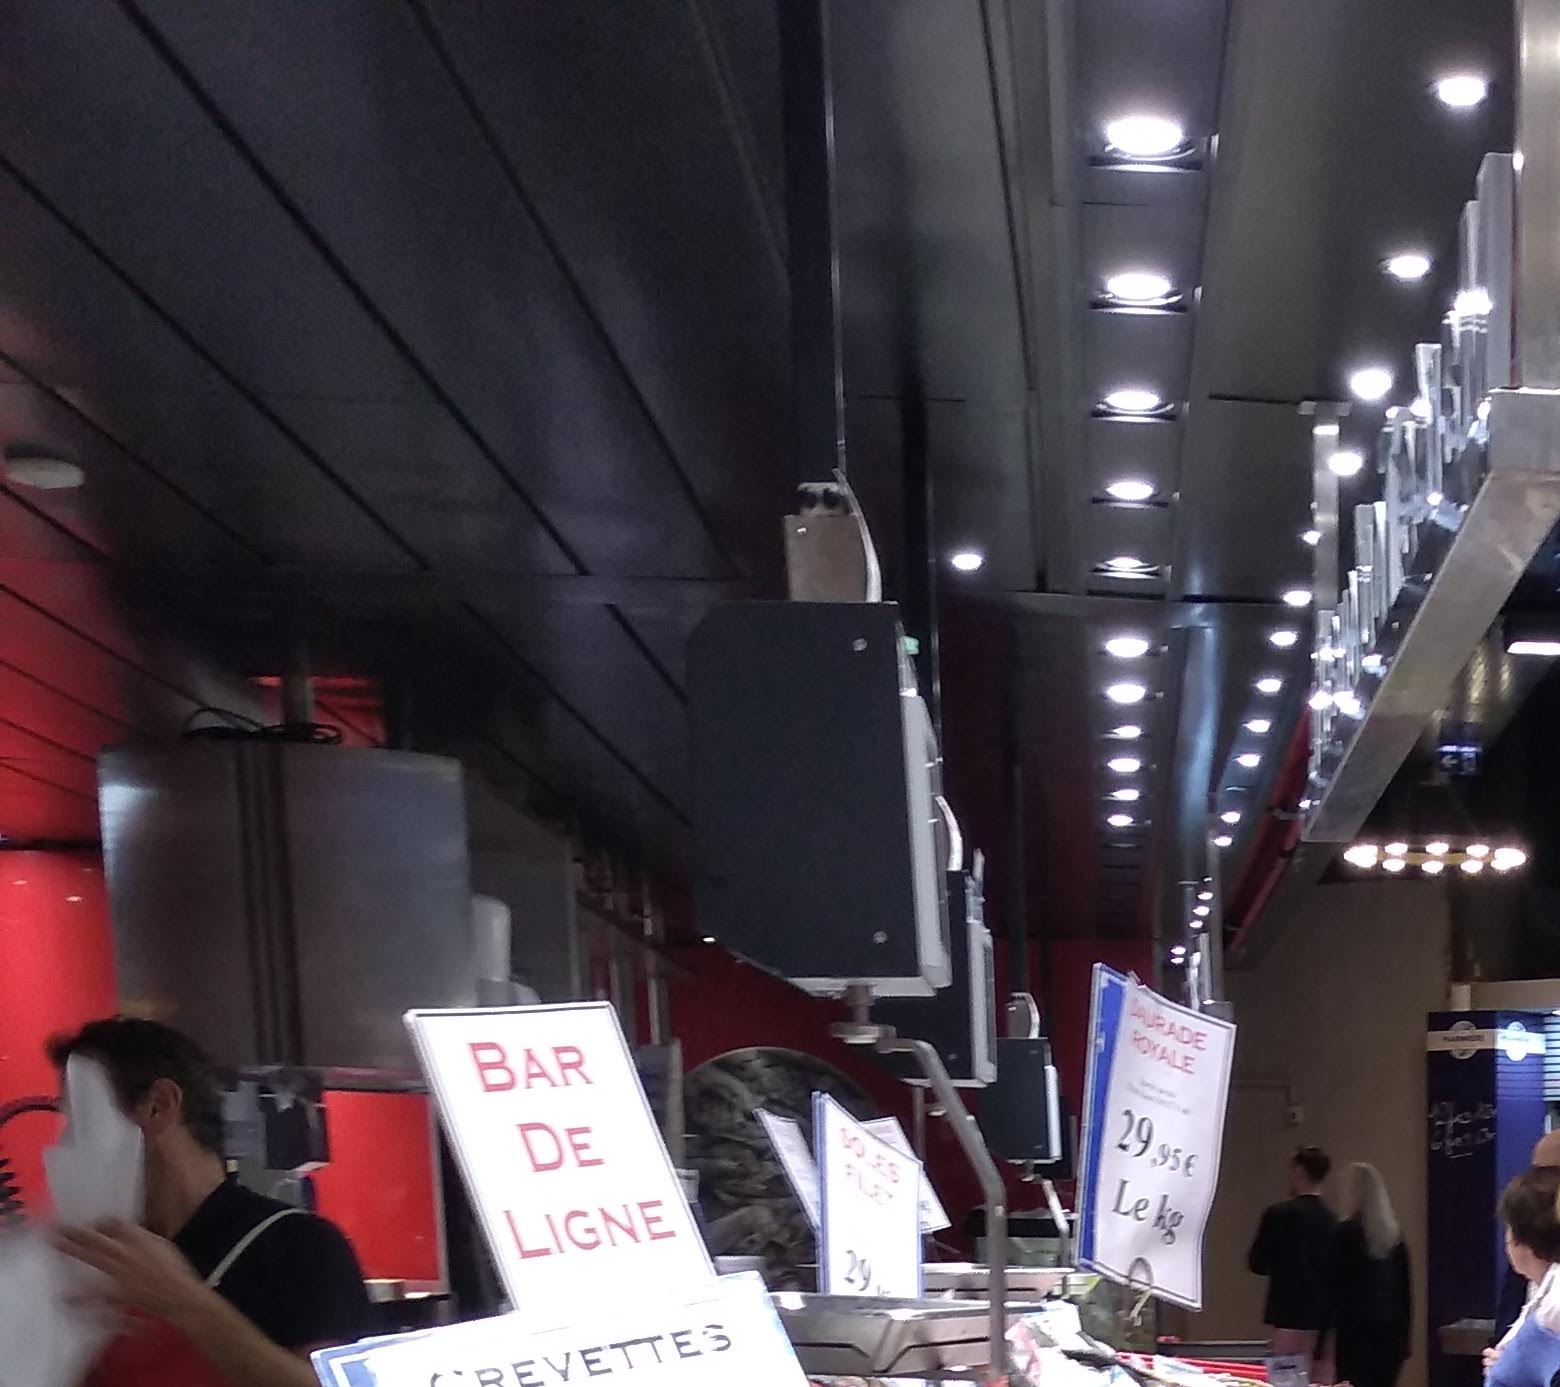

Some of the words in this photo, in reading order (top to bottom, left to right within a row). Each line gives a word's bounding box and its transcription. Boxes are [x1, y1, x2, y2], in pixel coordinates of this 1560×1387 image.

[467, 1041, 594, 1093] BAR
[515, 1122, 606, 1173] DE
[503, 1200, 678, 1260] LIGNE
[1111, 1178, 1150, 1222] Le
[1151, 1193, 1185, 1245] kg
